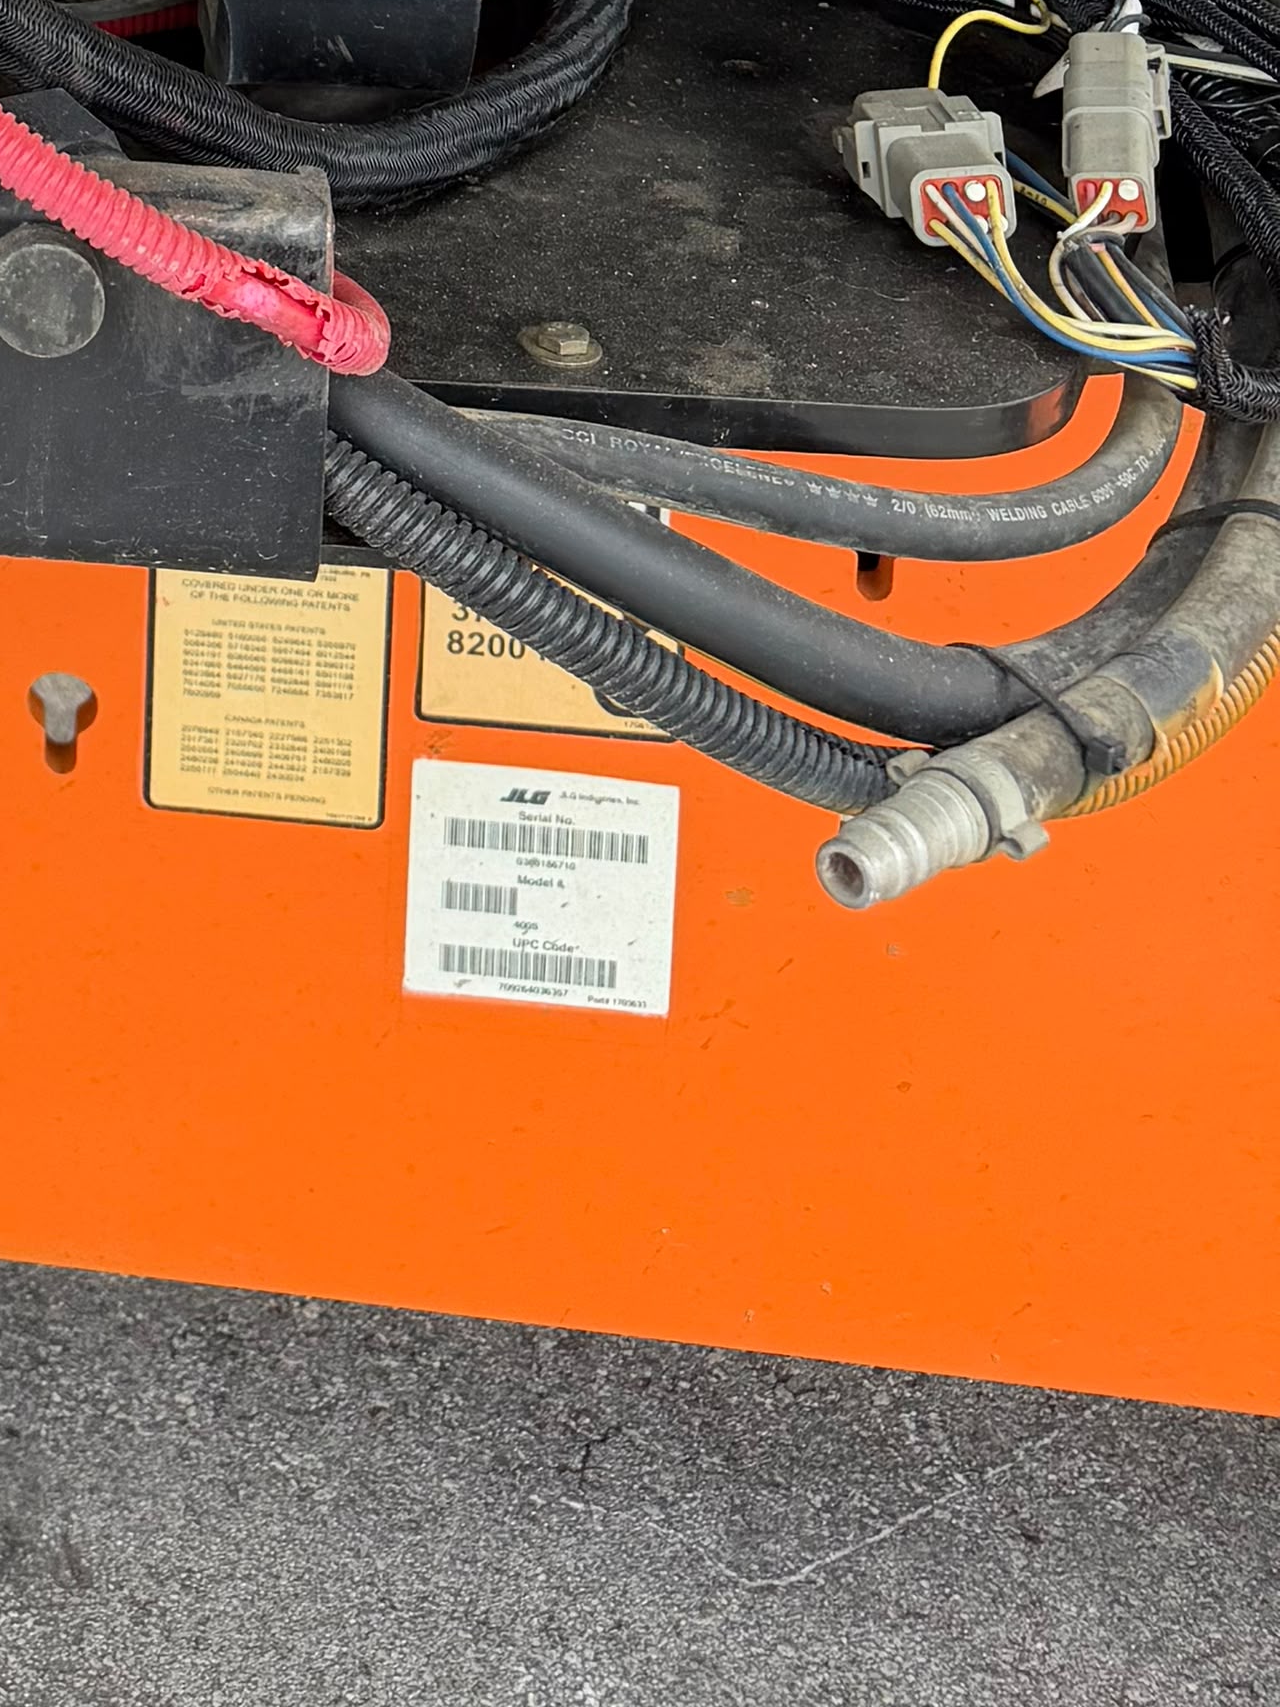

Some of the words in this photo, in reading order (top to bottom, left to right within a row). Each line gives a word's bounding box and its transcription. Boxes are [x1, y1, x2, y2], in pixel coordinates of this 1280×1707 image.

[891, 498, 917, 515] 2/0
[986, 506, 1048, 523] WELDING
[1052, 494, 1089, 517] CABLE
[447, 630, 526, 660] 8200
[500, 788, 551, 805] JLG
[518, 811, 552, 823] Serial
[556, 814, 575, 825] No.
[517, 875, 554, 888] Model
[512, 938, 539, 950] UPC
